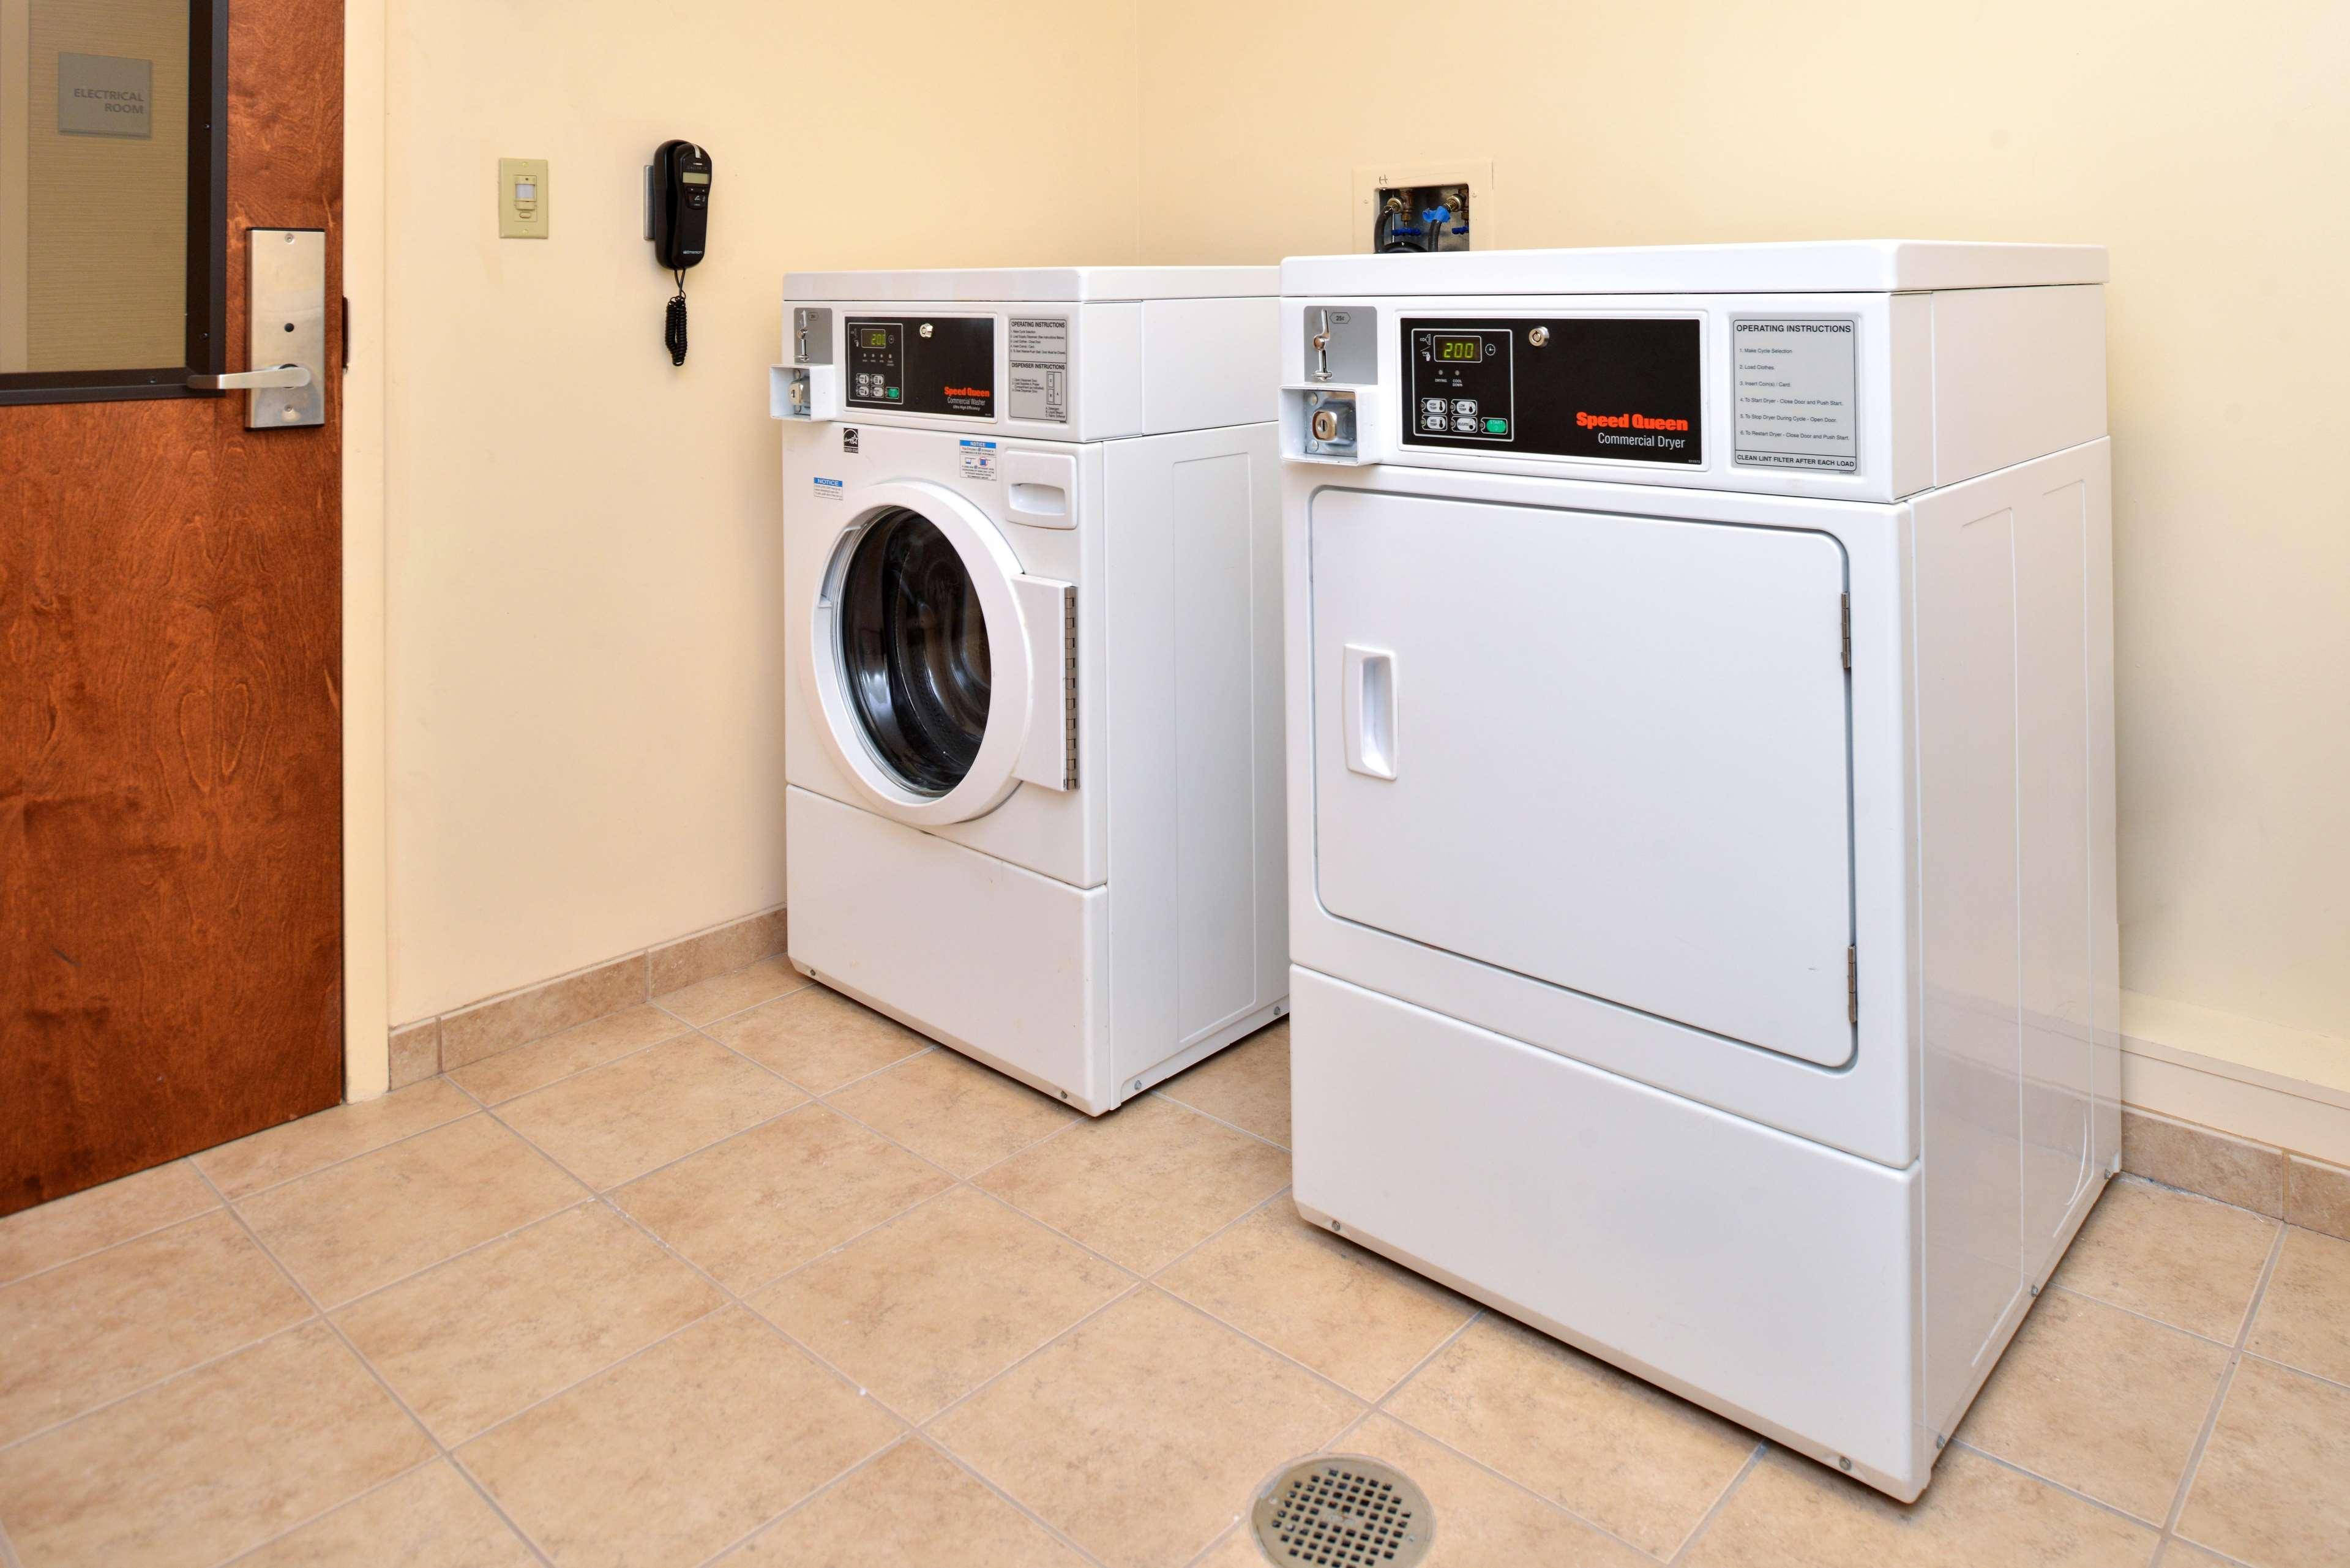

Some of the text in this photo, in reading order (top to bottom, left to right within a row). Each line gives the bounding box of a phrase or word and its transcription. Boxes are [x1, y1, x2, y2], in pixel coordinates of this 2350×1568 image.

[74, 88, 144, 102] ELECTRICAL
[105, 103, 144, 114] ROOM
[1443, 343, 1474, 358] 200
[944, 386, 990, 397] Speed Queen
[1576, 411, 1689, 431] Speed Queen
[1598, 431, 1685, 450] Commercial Dryer
